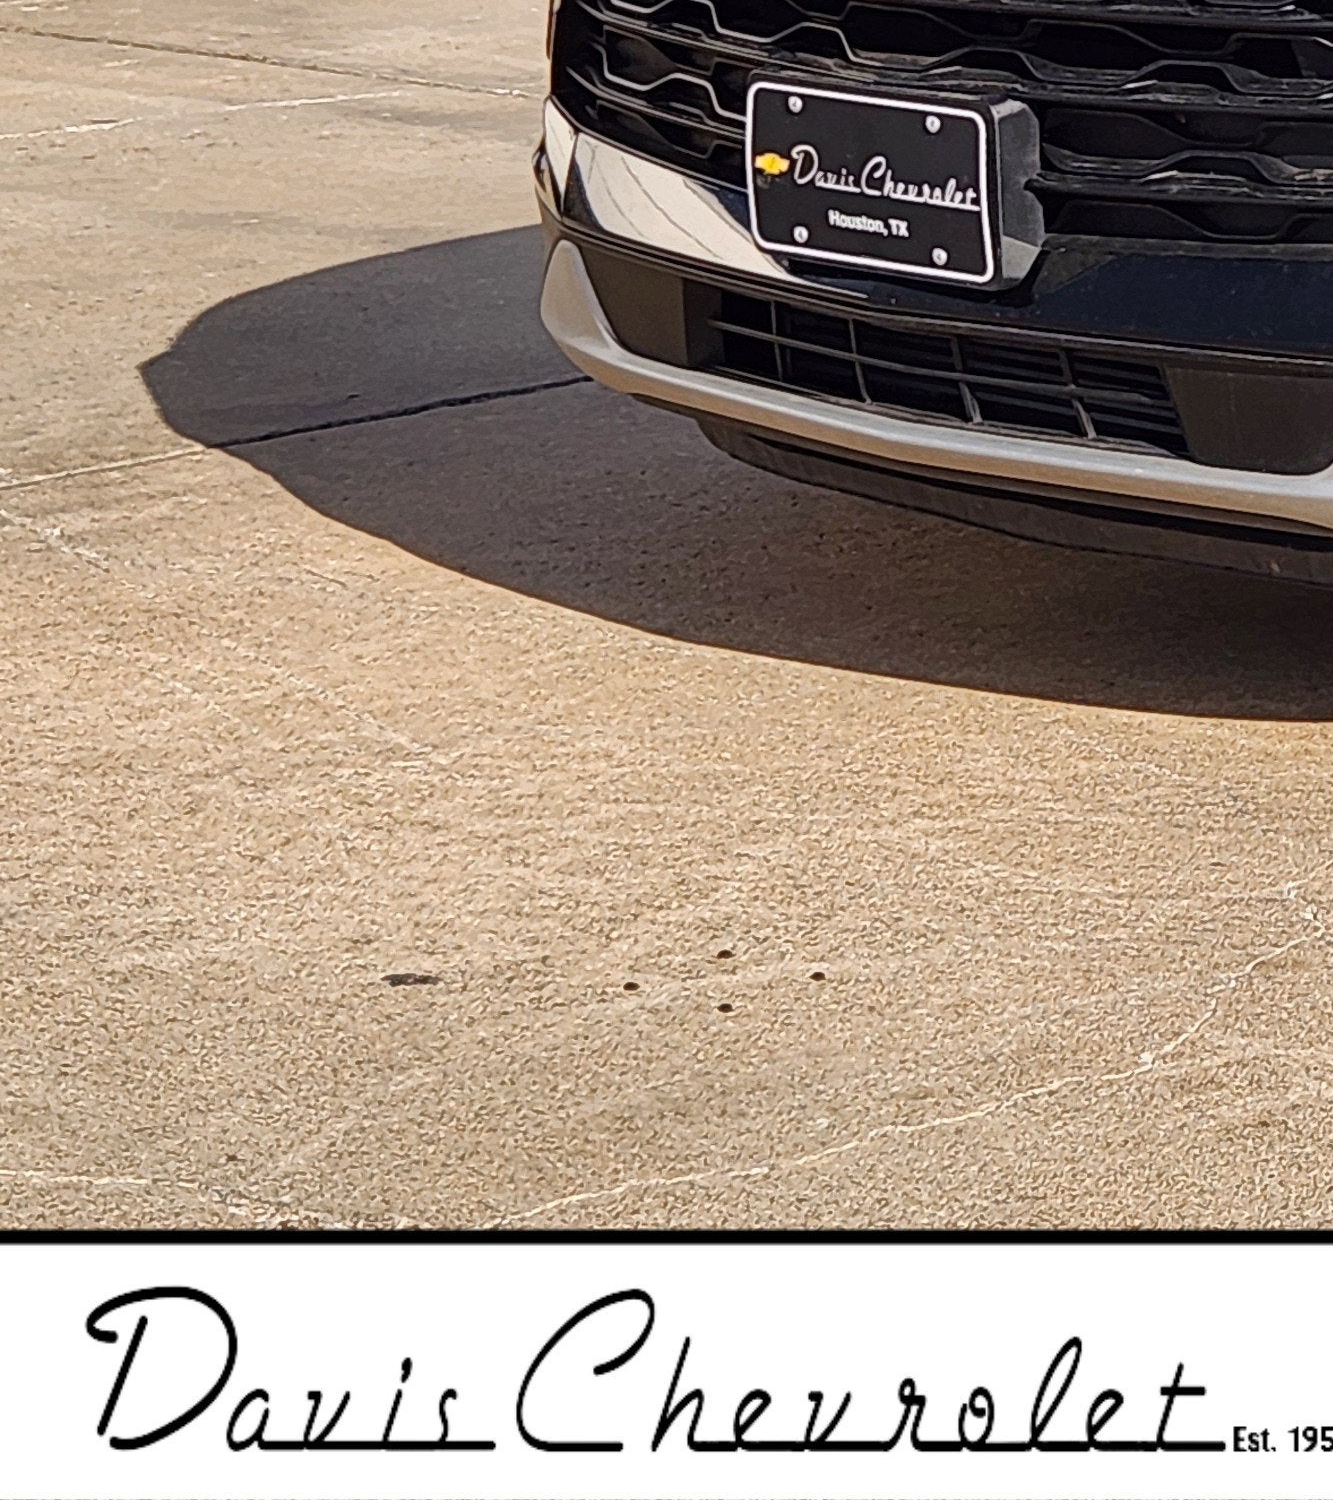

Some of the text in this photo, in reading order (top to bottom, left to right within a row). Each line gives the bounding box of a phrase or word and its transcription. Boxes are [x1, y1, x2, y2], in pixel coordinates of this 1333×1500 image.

[789, 143, 982, 212] Davis Chevrolet
[827, 208, 910, 238] Houston, TX
